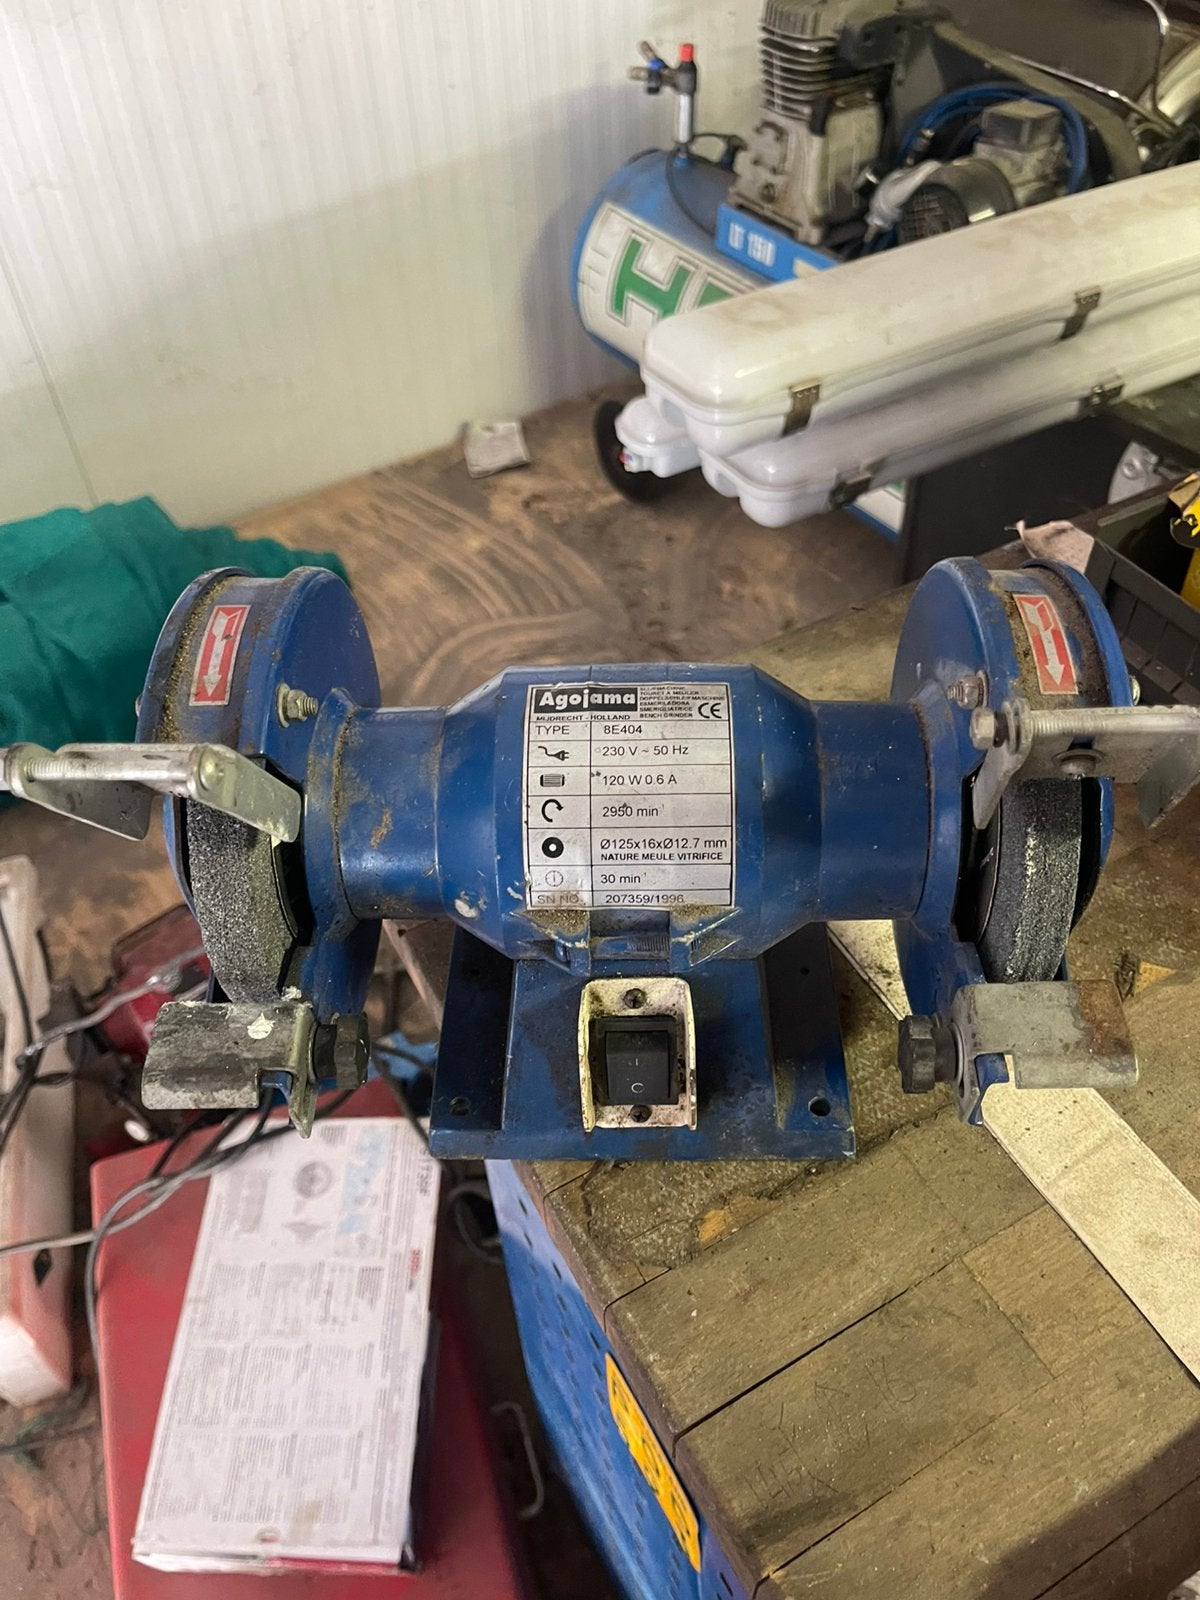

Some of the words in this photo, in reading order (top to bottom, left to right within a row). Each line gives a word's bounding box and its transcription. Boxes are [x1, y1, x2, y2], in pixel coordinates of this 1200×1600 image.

[539, 688, 636, 710] Agojama
[536, 725, 570, 735] TYPE
[603, 725, 642, 735] 8E404
[602, 746, 625, 757] 230
[628, 746, 638, 756] V
[653, 745, 669, 756] 50
[672, 744, 689, 756] Hz
[602, 775, 625, 786] 120
[628, 775, 642, 785] W
[667, 774, 677, 785] A
[602, 806, 633, 817] 2950
[704, 838, 727, 848] mm
[601, 852, 639, 861] NATURE
[642, 852, 674, 861] MEULE
[677, 852, 723, 861] VITRIFICE
[600, 873, 616, 884] 30
[537, 894, 556, 904] SN
[605, 894, 684, 904] 207359/1996
